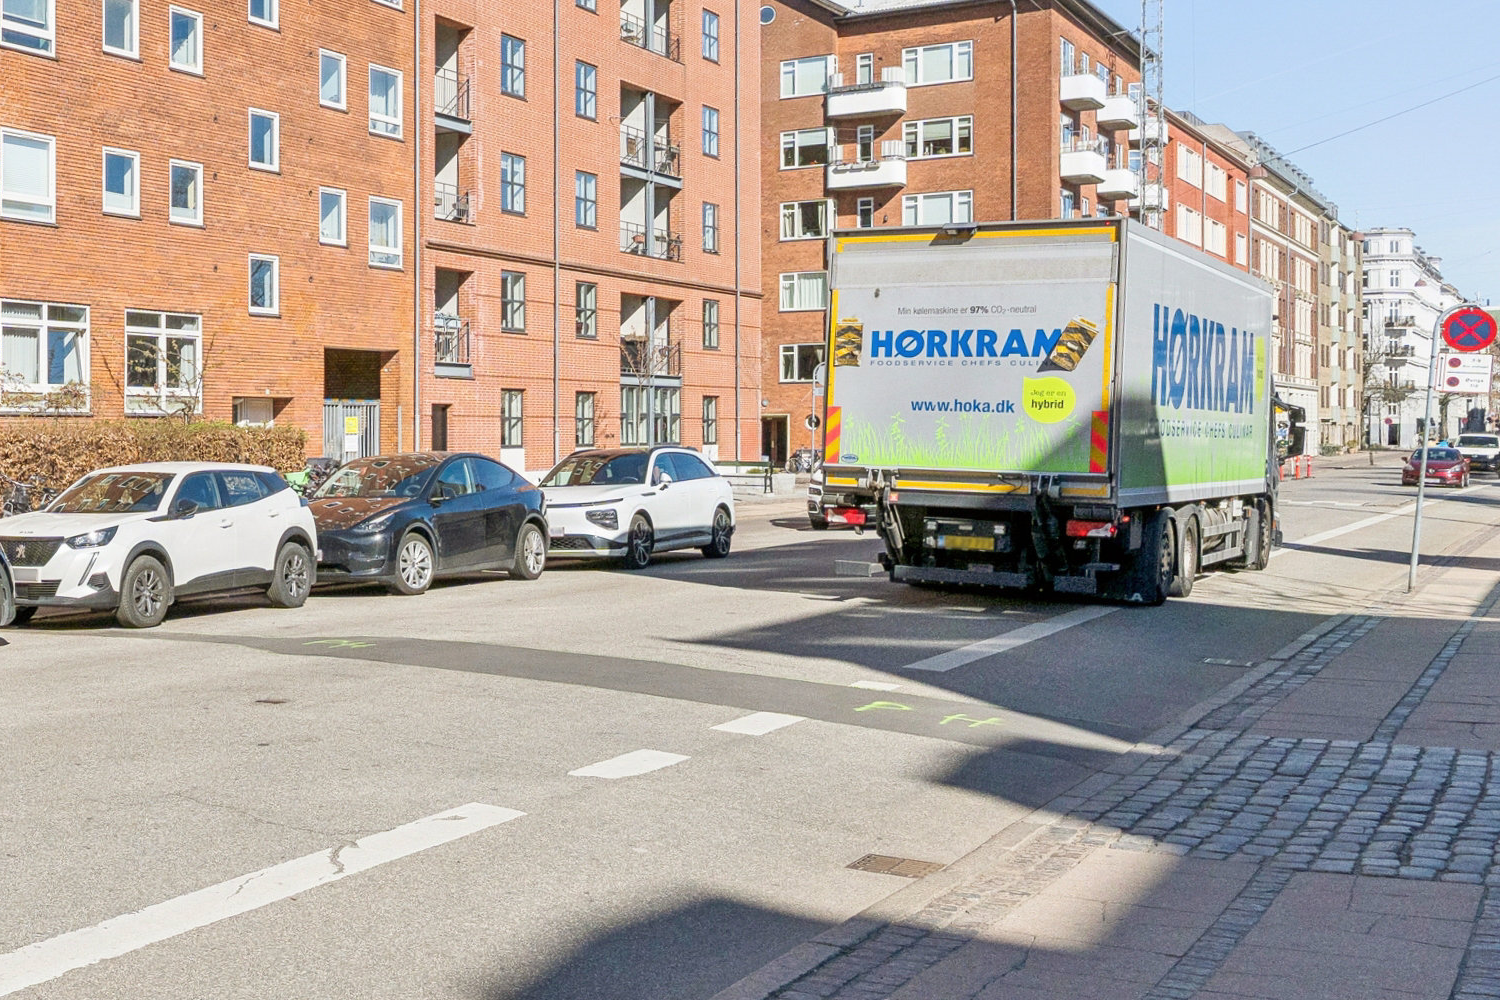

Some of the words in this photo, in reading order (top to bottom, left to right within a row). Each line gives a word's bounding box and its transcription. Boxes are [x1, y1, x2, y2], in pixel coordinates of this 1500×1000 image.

[969, 305, 989, 314] 97%
[871, 329, 1062, 358] HØRKRAM
[1151, 303, 1254, 415] HØRKRAM
[911, 398, 1015, 413] www.hoka.dk
[1031, 399, 1064, 410] hybrid
